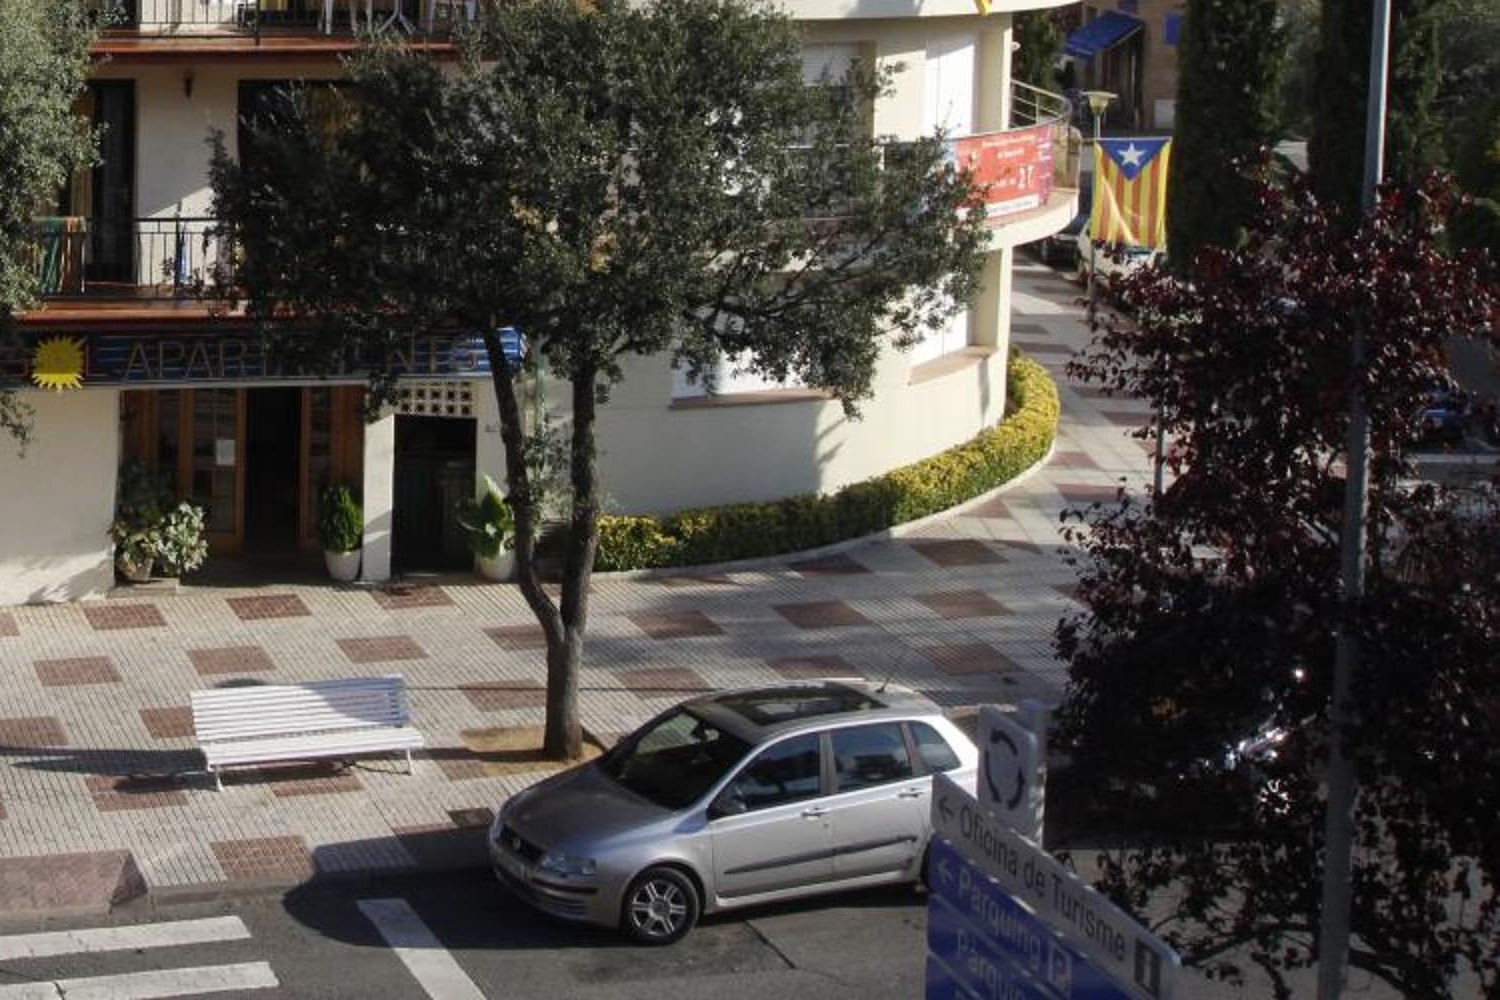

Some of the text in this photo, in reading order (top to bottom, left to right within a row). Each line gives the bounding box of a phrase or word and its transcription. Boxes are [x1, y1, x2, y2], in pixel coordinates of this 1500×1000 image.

[960, 804, 1018, 882] Oficina
[1023, 858, 1046, 897] de
[1051, 873, 1125, 963] Turisme
